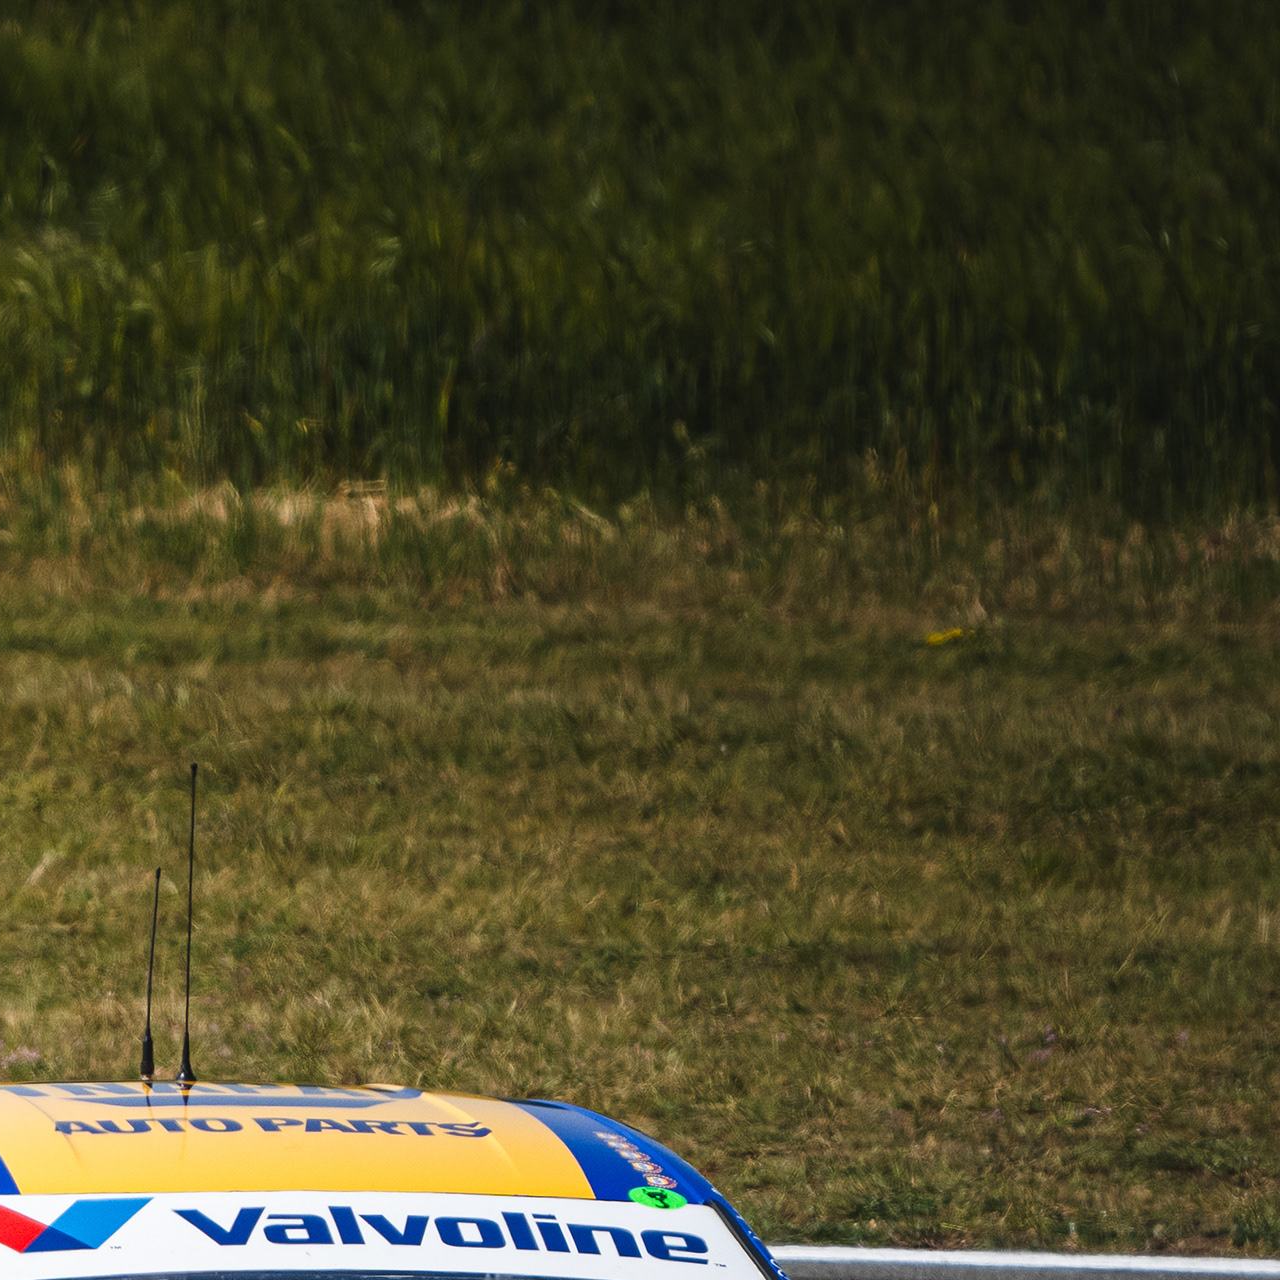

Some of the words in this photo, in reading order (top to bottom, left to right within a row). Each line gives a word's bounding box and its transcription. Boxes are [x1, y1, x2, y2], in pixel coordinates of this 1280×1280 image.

[54, 1116, 244, 1135] AUTO
[252, 1117, 493, 1138] PARTS
[172, 1205, 711, 1266] Valvoline
